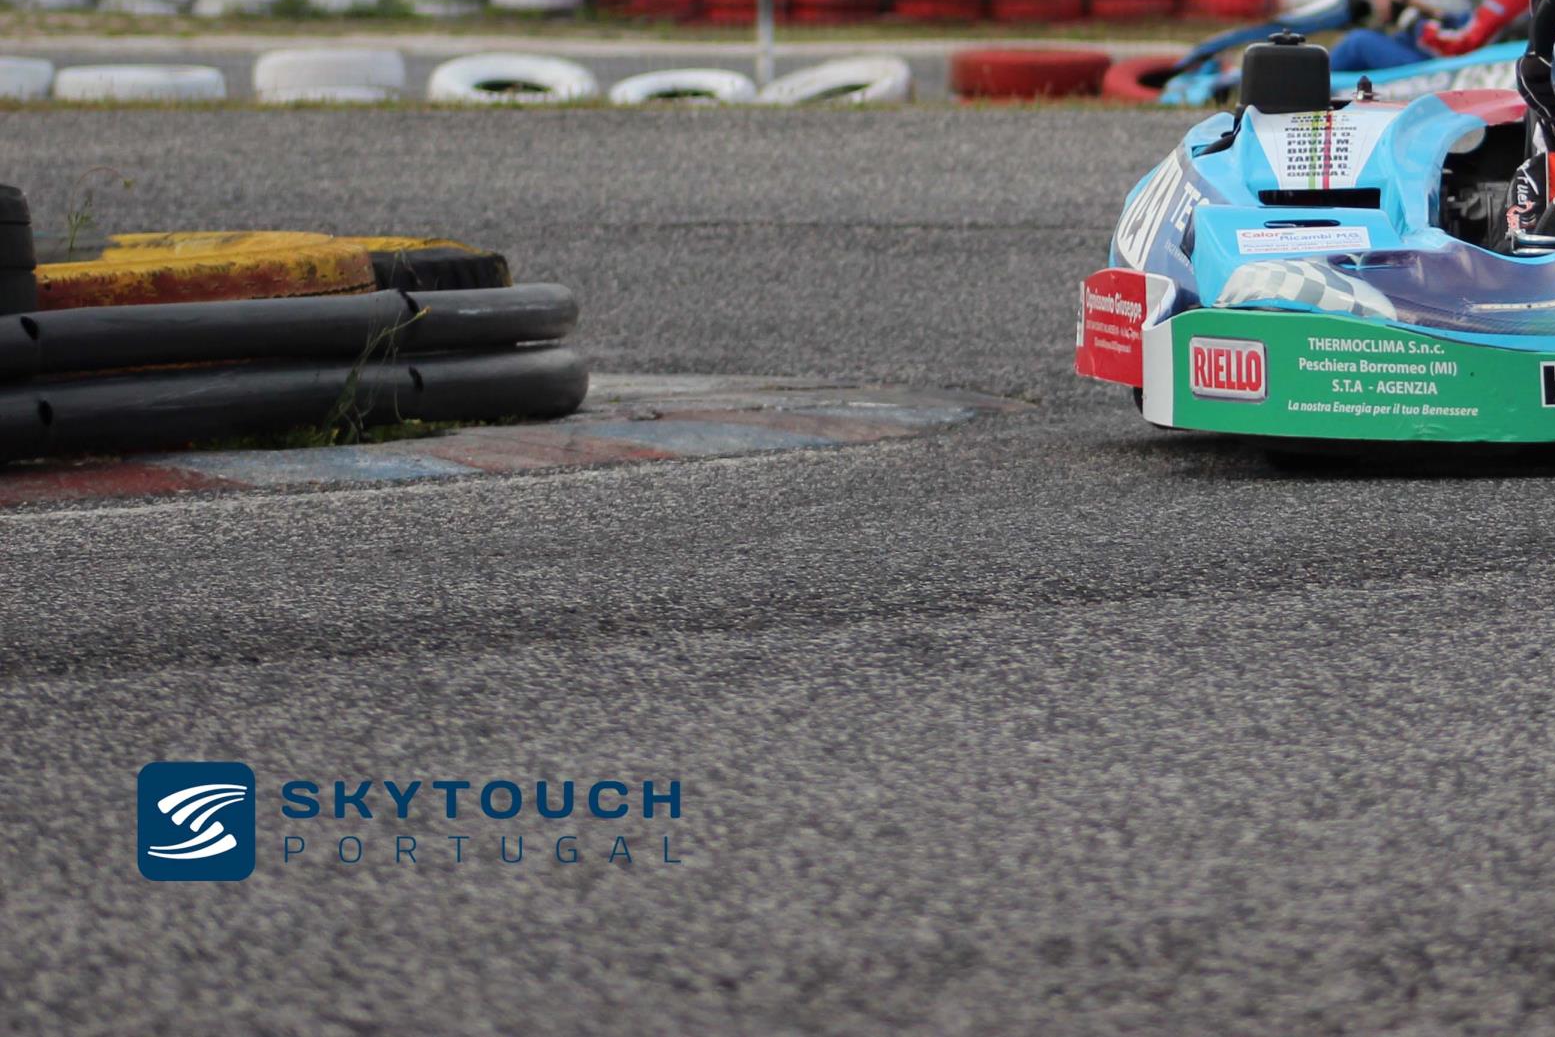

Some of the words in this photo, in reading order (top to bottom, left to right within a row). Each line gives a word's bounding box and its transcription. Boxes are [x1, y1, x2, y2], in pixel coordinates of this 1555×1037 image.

[1241, 231, 1281, 239] Calor
[1307, 337, 1405, 354] THERMOCLIMA
[1408, 340, 1445, 355] S.n.c.
[1193, 346, 1262, 392] RIELLO
[1298, 357, 1358, 373] Peschiera
[1359, 359, 1427, 375] Borromeo
[1430, 361, 1458, 377] (MI)
[1331, 378, 1363, 394] S.T.A
[1376, 380, 1438, 395] AGENZIA
[1287, 399, 1300, 412] La
[1300, 401, 1331, 413] nostra
[1333, 401, 1373, 416] Energia
[1372, 404, 1391, 416] per
[1391, 403, 1401, 415] il
[1401, 404, 1420, 415] tuo
[1421, 404, 1479, 416] Benessere
